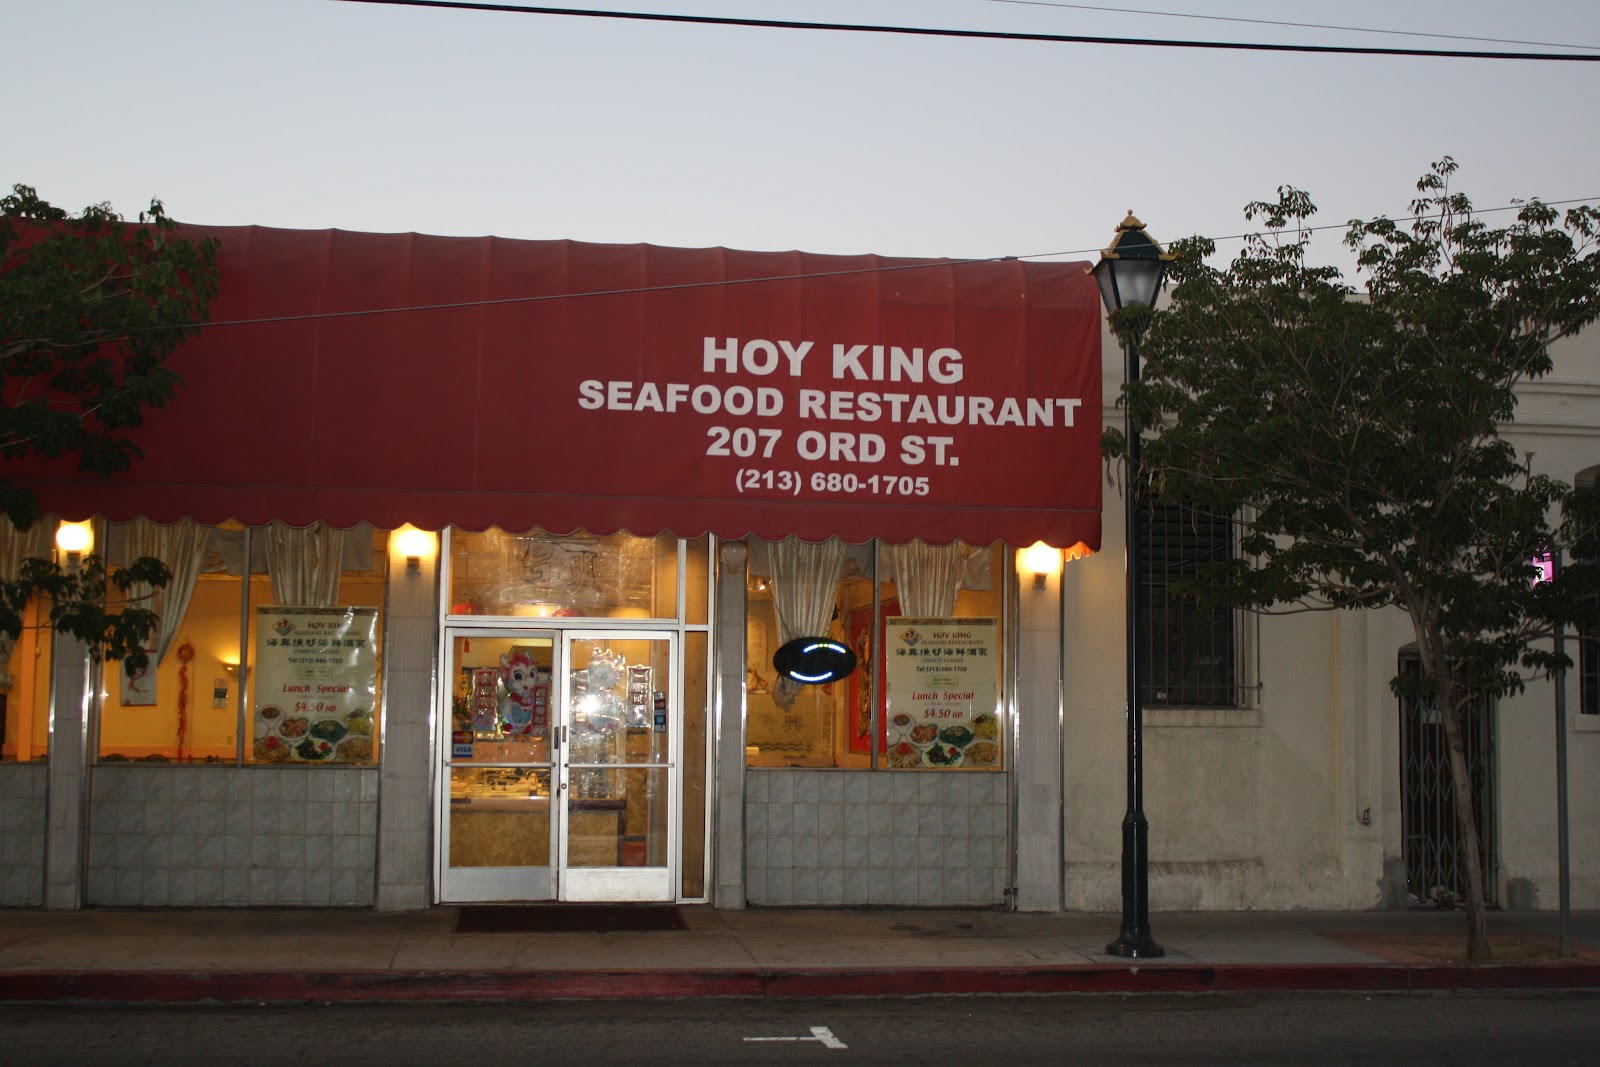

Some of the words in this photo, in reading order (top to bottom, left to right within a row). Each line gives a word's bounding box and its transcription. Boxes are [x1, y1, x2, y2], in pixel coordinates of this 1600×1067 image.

[704, 336, 815, 376] HOY
[832, 344, 964, 384] KING
[578, 380, 784, 416] SEAFOOD
[799, 389, 1082, 427] RESTAURANT
[705, 426, 783, 458] 207
[796, 431, 886, 463] ORD
[900, 435, 959, 466] ST.
[735, 469, 802, 495] (213)
[811, 472, 930, 496] 680-1705
[282, 684, 311, 693] Lunch
[316, 684, 350, 694] Special
[912, 692, 938, 700] Lunch
[943, 692, 974, 701] Special
[294, 702, 324, 712] $4.50
[325, 704, 337, 712] up
[924, 708, 951, 718] $4.50
